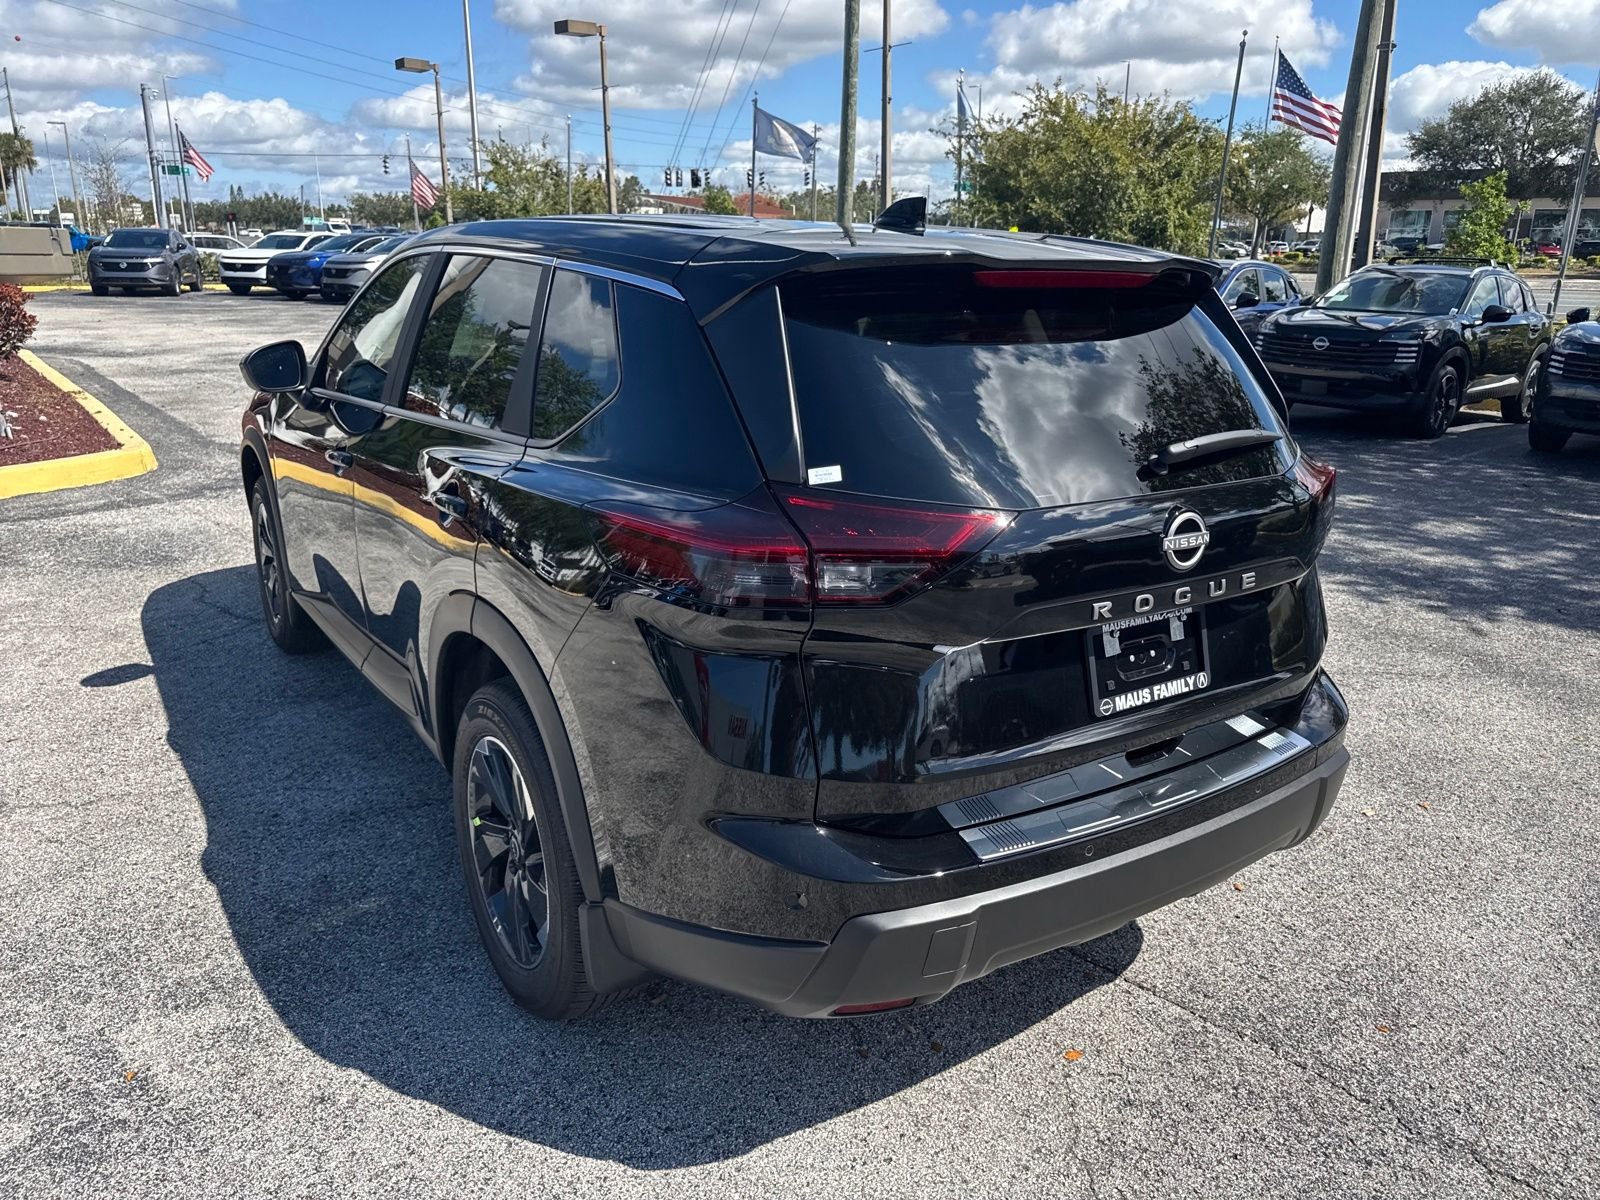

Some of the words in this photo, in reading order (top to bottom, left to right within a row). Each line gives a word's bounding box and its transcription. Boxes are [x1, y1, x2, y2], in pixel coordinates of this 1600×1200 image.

[1164, 534, 1210, 550] NISSAN
[1092, 571, 1257, 621] ROGUE
[1115, 688, 1152, 712] MAUS
[1153, 676, 1196, 701] FAMILY
